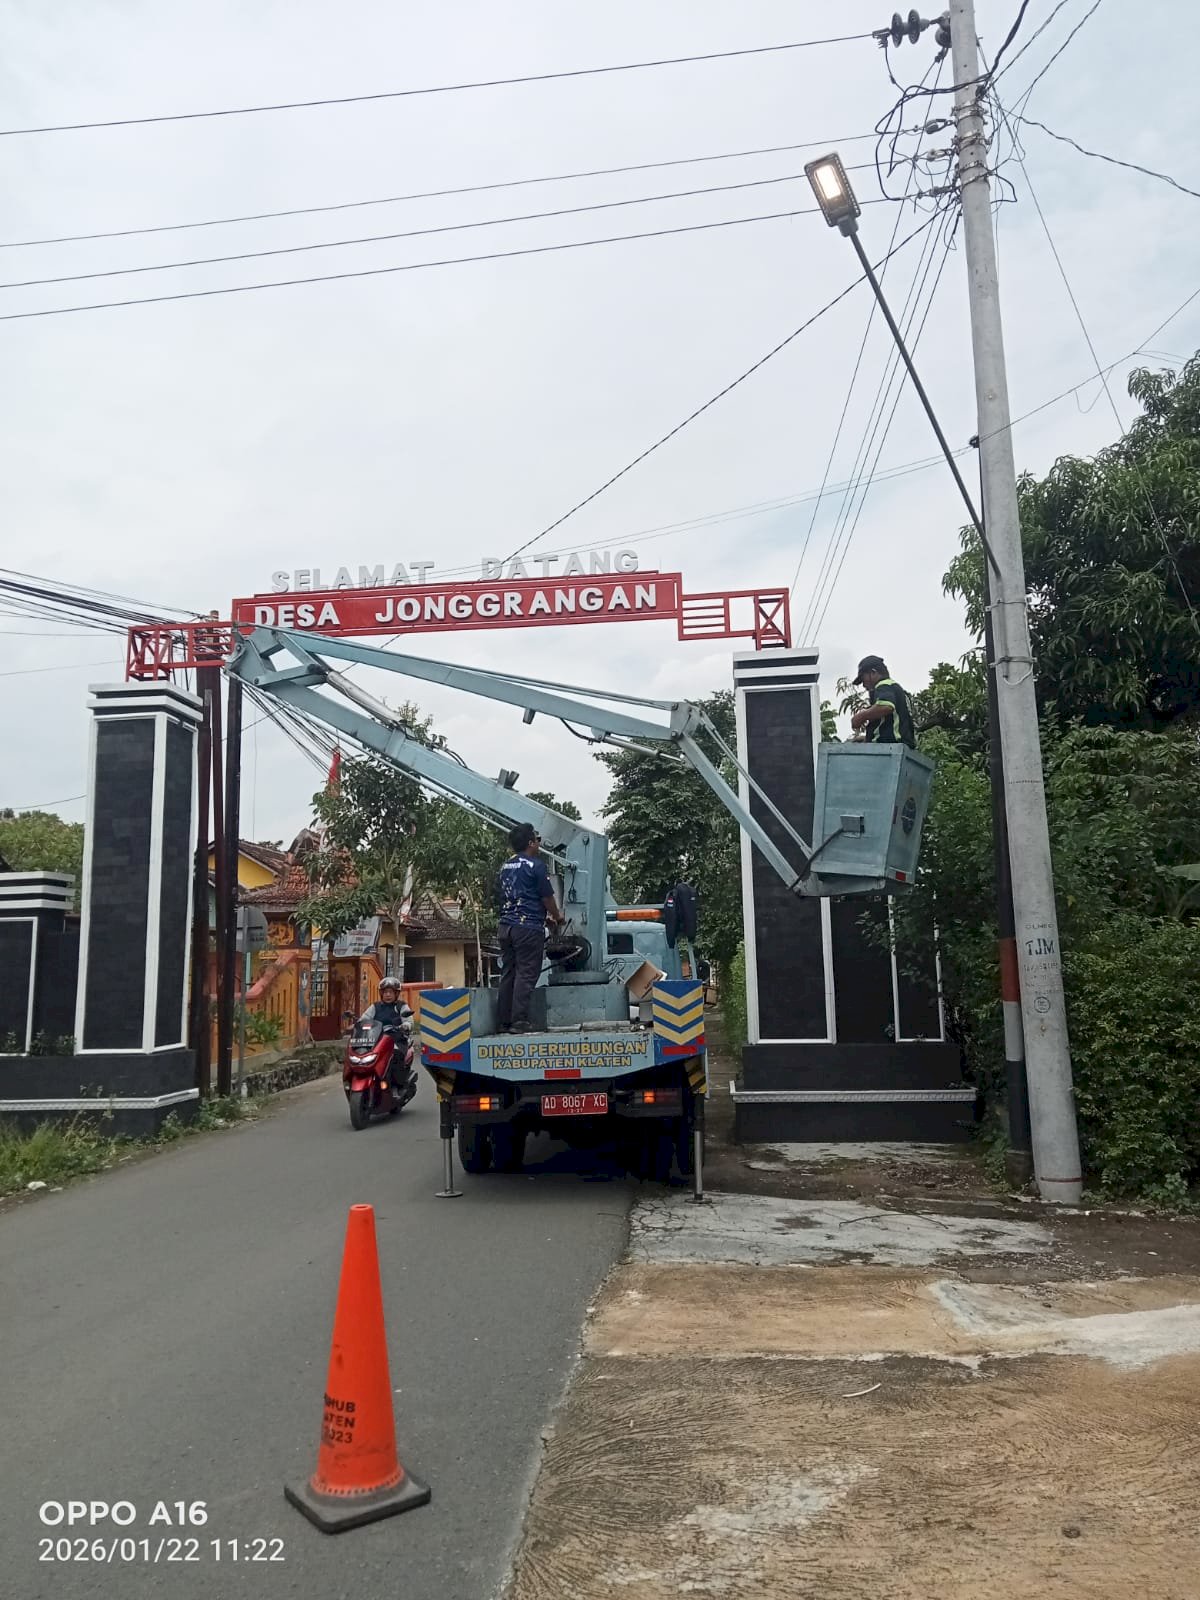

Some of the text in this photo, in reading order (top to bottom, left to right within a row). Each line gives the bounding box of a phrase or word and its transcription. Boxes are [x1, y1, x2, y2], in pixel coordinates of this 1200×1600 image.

[271, 550, 639, 593] SELAMAT DATANG
[254, 583, 657, 628] DESA JONGGRANGAN
[478, 1040, 647, 1058] DINAS PERHUBUNGAN
[493, 1055, 632, 1069] KABUPATEN KLATEN
[544, 1094, 606, 1109] AD 8067 XC
